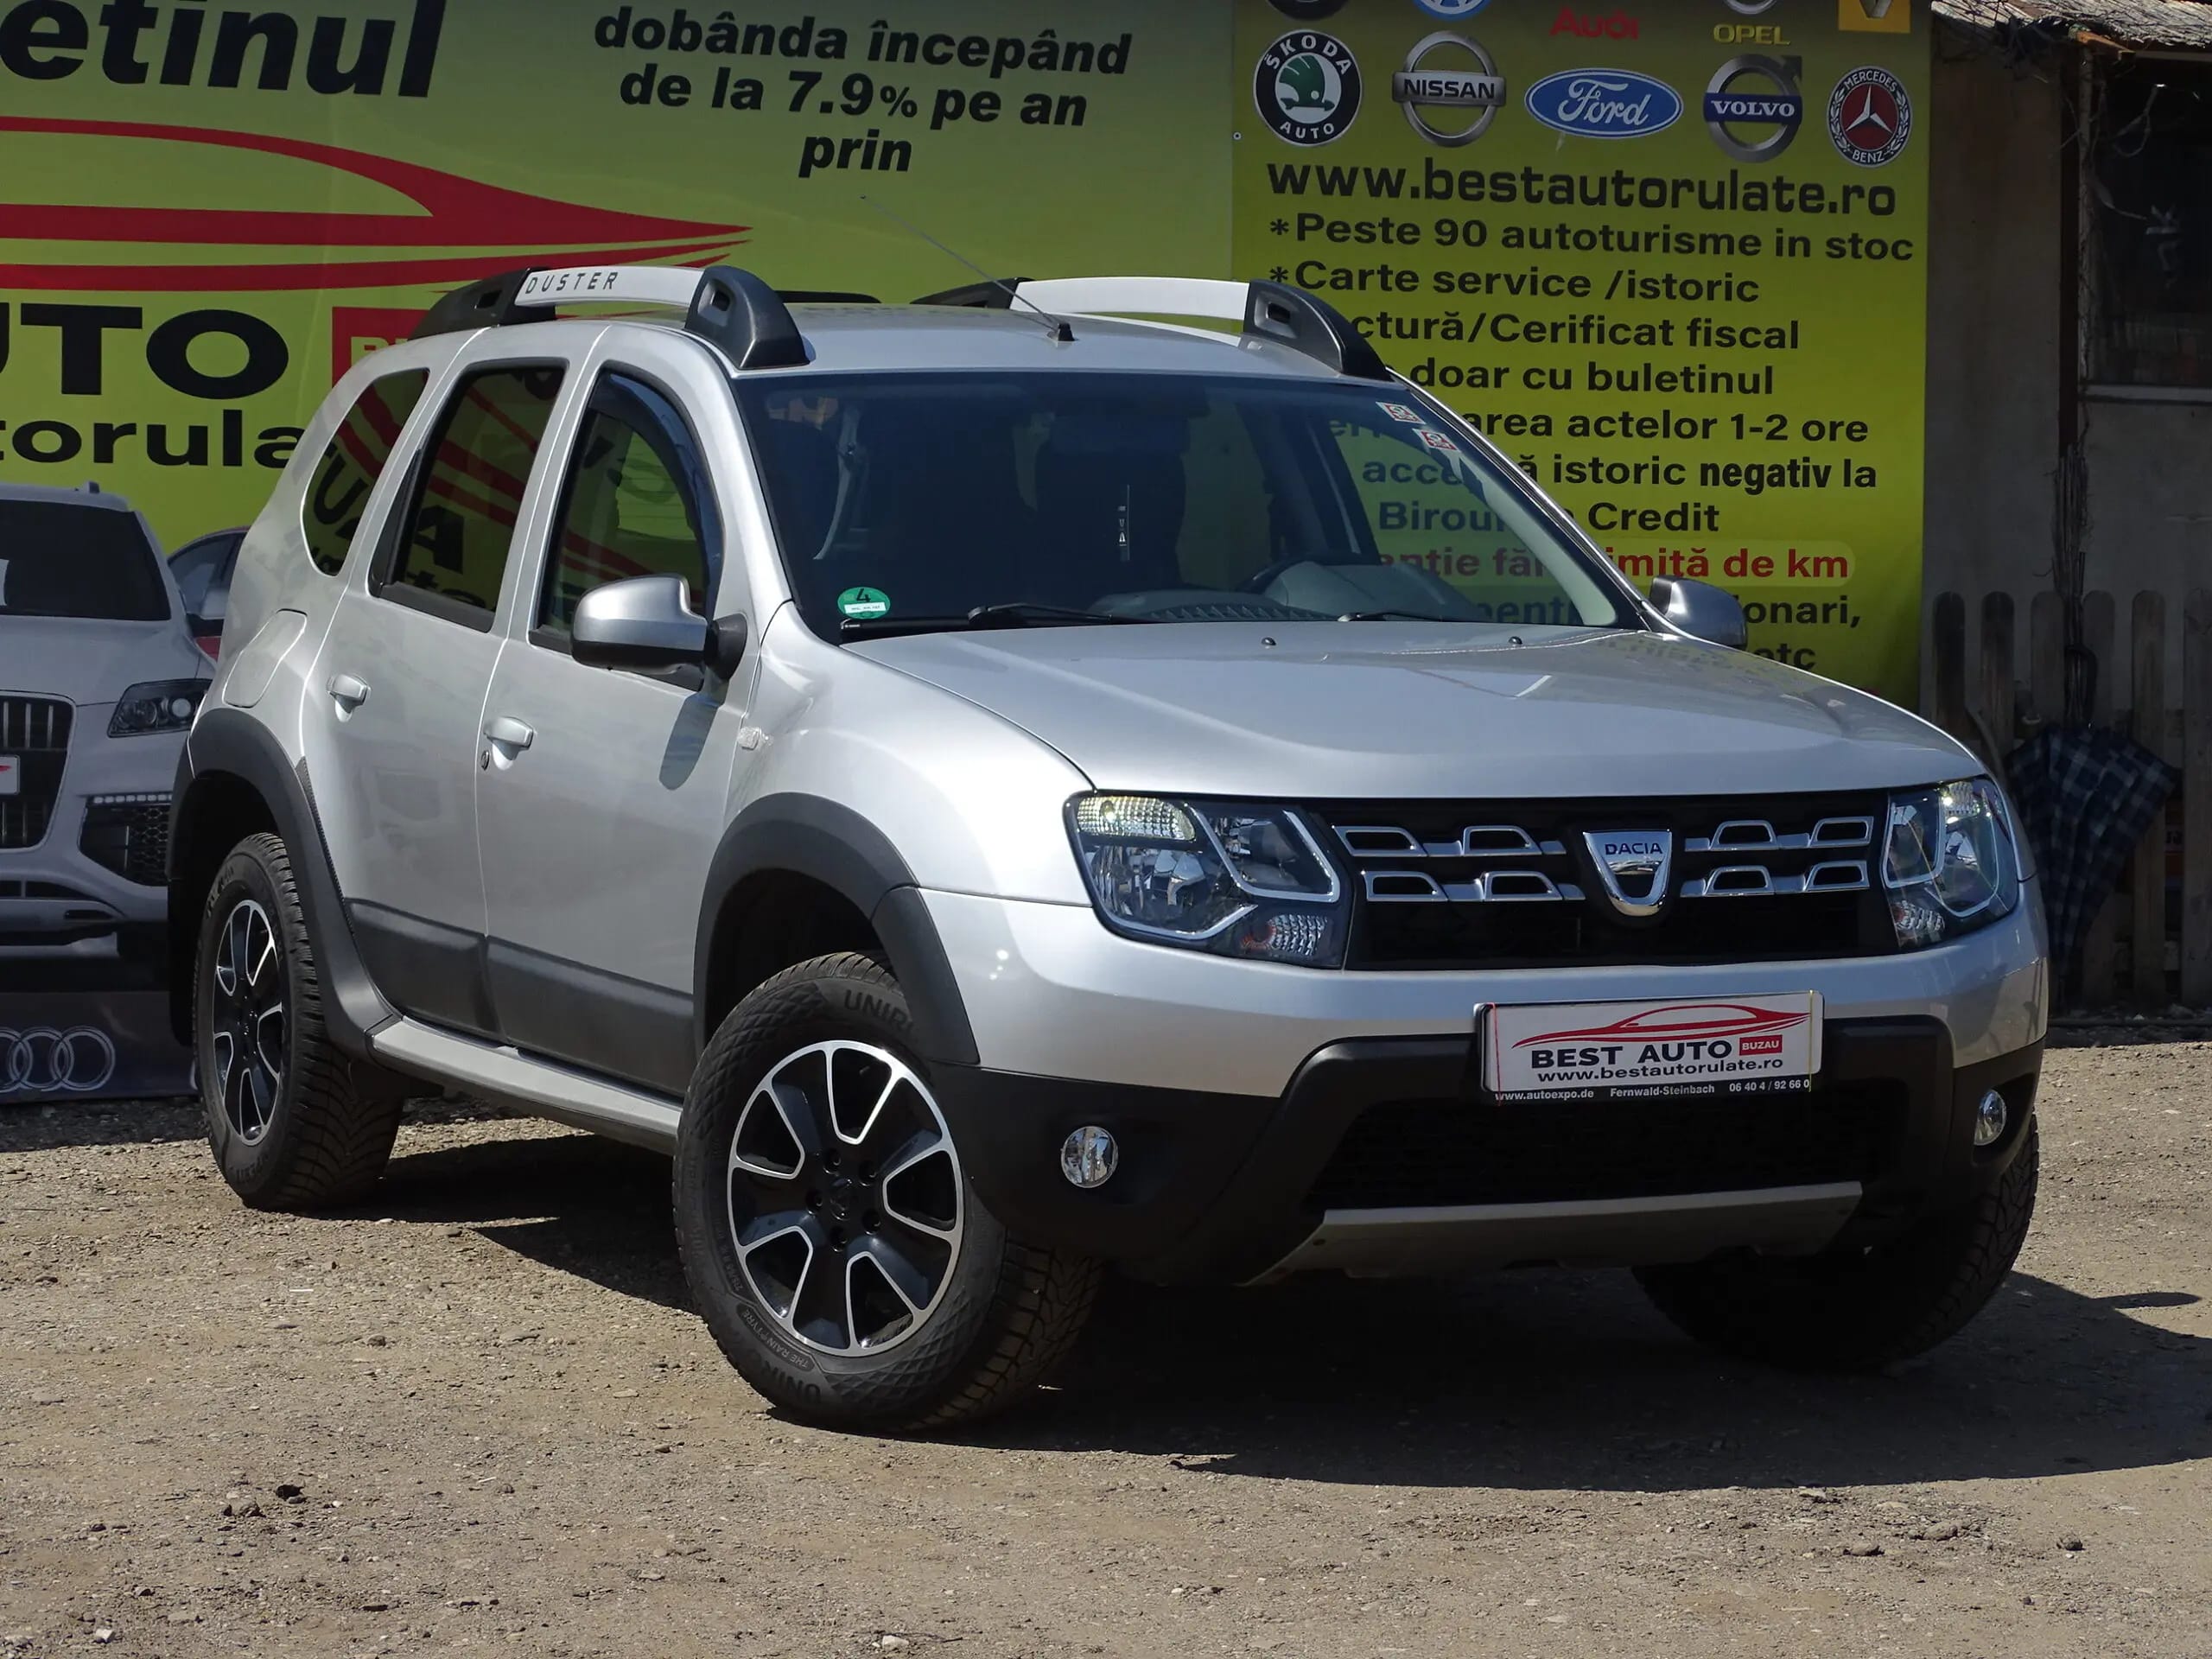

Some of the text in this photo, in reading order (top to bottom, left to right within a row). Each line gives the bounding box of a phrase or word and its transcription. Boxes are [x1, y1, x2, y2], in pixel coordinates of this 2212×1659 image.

[1549, 5, 1639, 41] Audi
[1713, 23, 1791, 45] OPEL
[594, 6, 1133, 79] dobânda începând
[1403, 78, 1496, 100] NISSAN
[1845, 70, 1898, 92] MERCEDES
[619, 62, 1087, 130] de la 7.9% pe an
[1558, 79, 1651, 128] Ford
[1711, 100, 1795, 118] VOLVO
[1280, 121, 1335, 139] AUTO
[798, 129, 913, 178] prin
[1853, 149, 1885, 163] BENZ
[1267, 158, 1897, 217] www.bestautorulate.ro
[1434, 219, 1488, 248] 90
[1501, 222, 1762, 257] autoturisme
[1775, 226, 1811, 257] in
[1825, 231, 1914, 262] stoc
[525, 271, 619, 294] DUSTER
[1433, 267, 1592, 298] service
[1605, 270, 1759, 304] /istoric
[1688, 317, 1800, 350] fiscal
[0, 302, 289, 399] TO
[1409, 357, 1773, 395] doar cu buletinul
[1567, 410, 1718, 440] actelor
[1732, 412, 1789, 442] 1-2
[1802, 420, 1869, 442] ore
[1554, 454, 1686, 486] istoric
[1700, 460, 1831, 494] negativ
[1842, 461, 1877, 488] la
[1588, 502, 1719, 531] Credit
[1724, 549, 1774, 577] de
[1788, 549, 1848, 577] km
[856, 588, 871, 602] 4
[1605, 843, 1663, 855] DACIA
[1530, 1039, 1732, 1069] BEST AUTO
[1741, 1039, 1779, 1051] BUZAU
[1537, 1057, 1783, 1083] www.bestautorulate.ro
[1495, 1089, 1594, 1101] www.autoexpo.de
[1745, 1082, 1757, 1091] 40
[1774, 1080, 1786, 1090] 92
